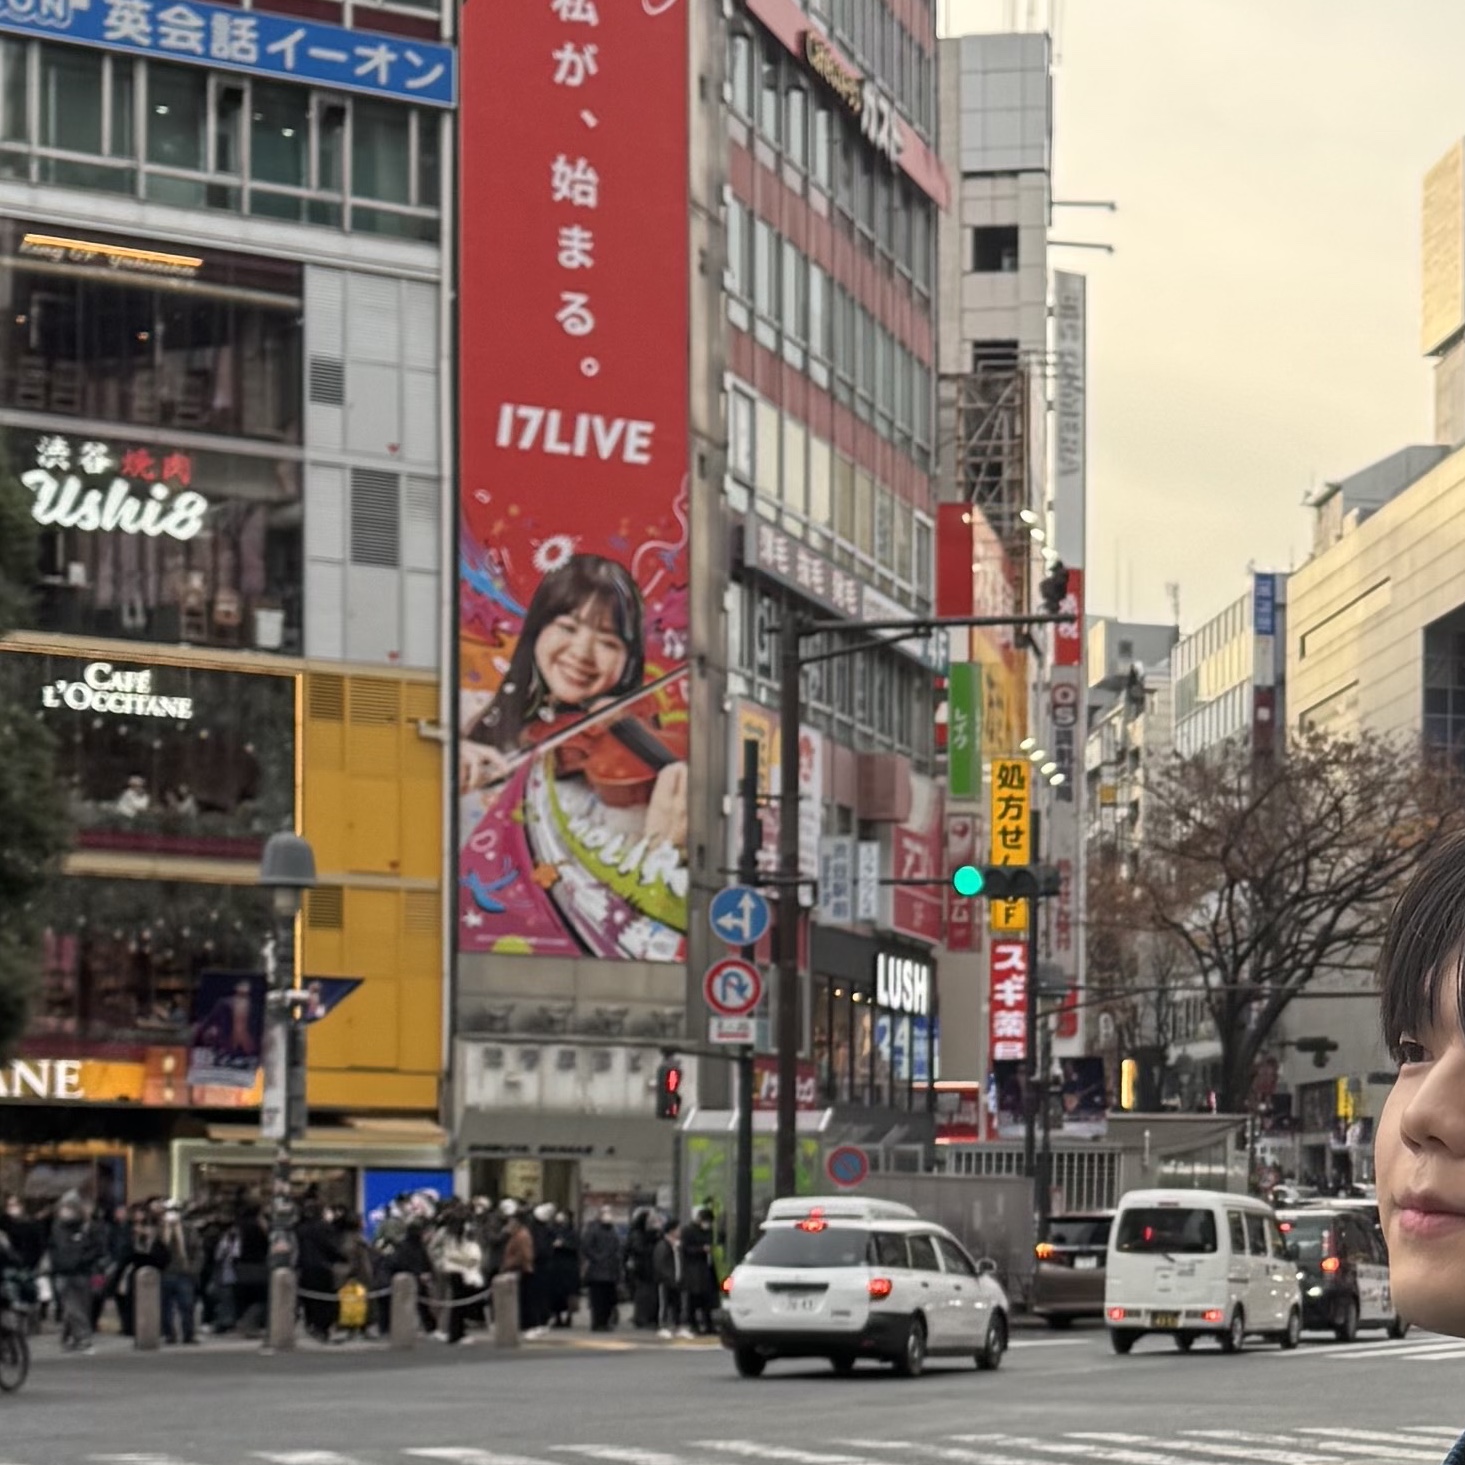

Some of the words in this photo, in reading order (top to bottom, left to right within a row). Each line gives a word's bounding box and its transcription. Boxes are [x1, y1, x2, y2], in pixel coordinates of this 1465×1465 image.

[104, 0, 445, 89] 英会話イーオン
[496, 402, 655, 465] 17LIVE
[21, 468, 209, 541] Ushi8
[877, 952, 928, 1015] LUSH
[0, 1058, 85, 1099] NE
